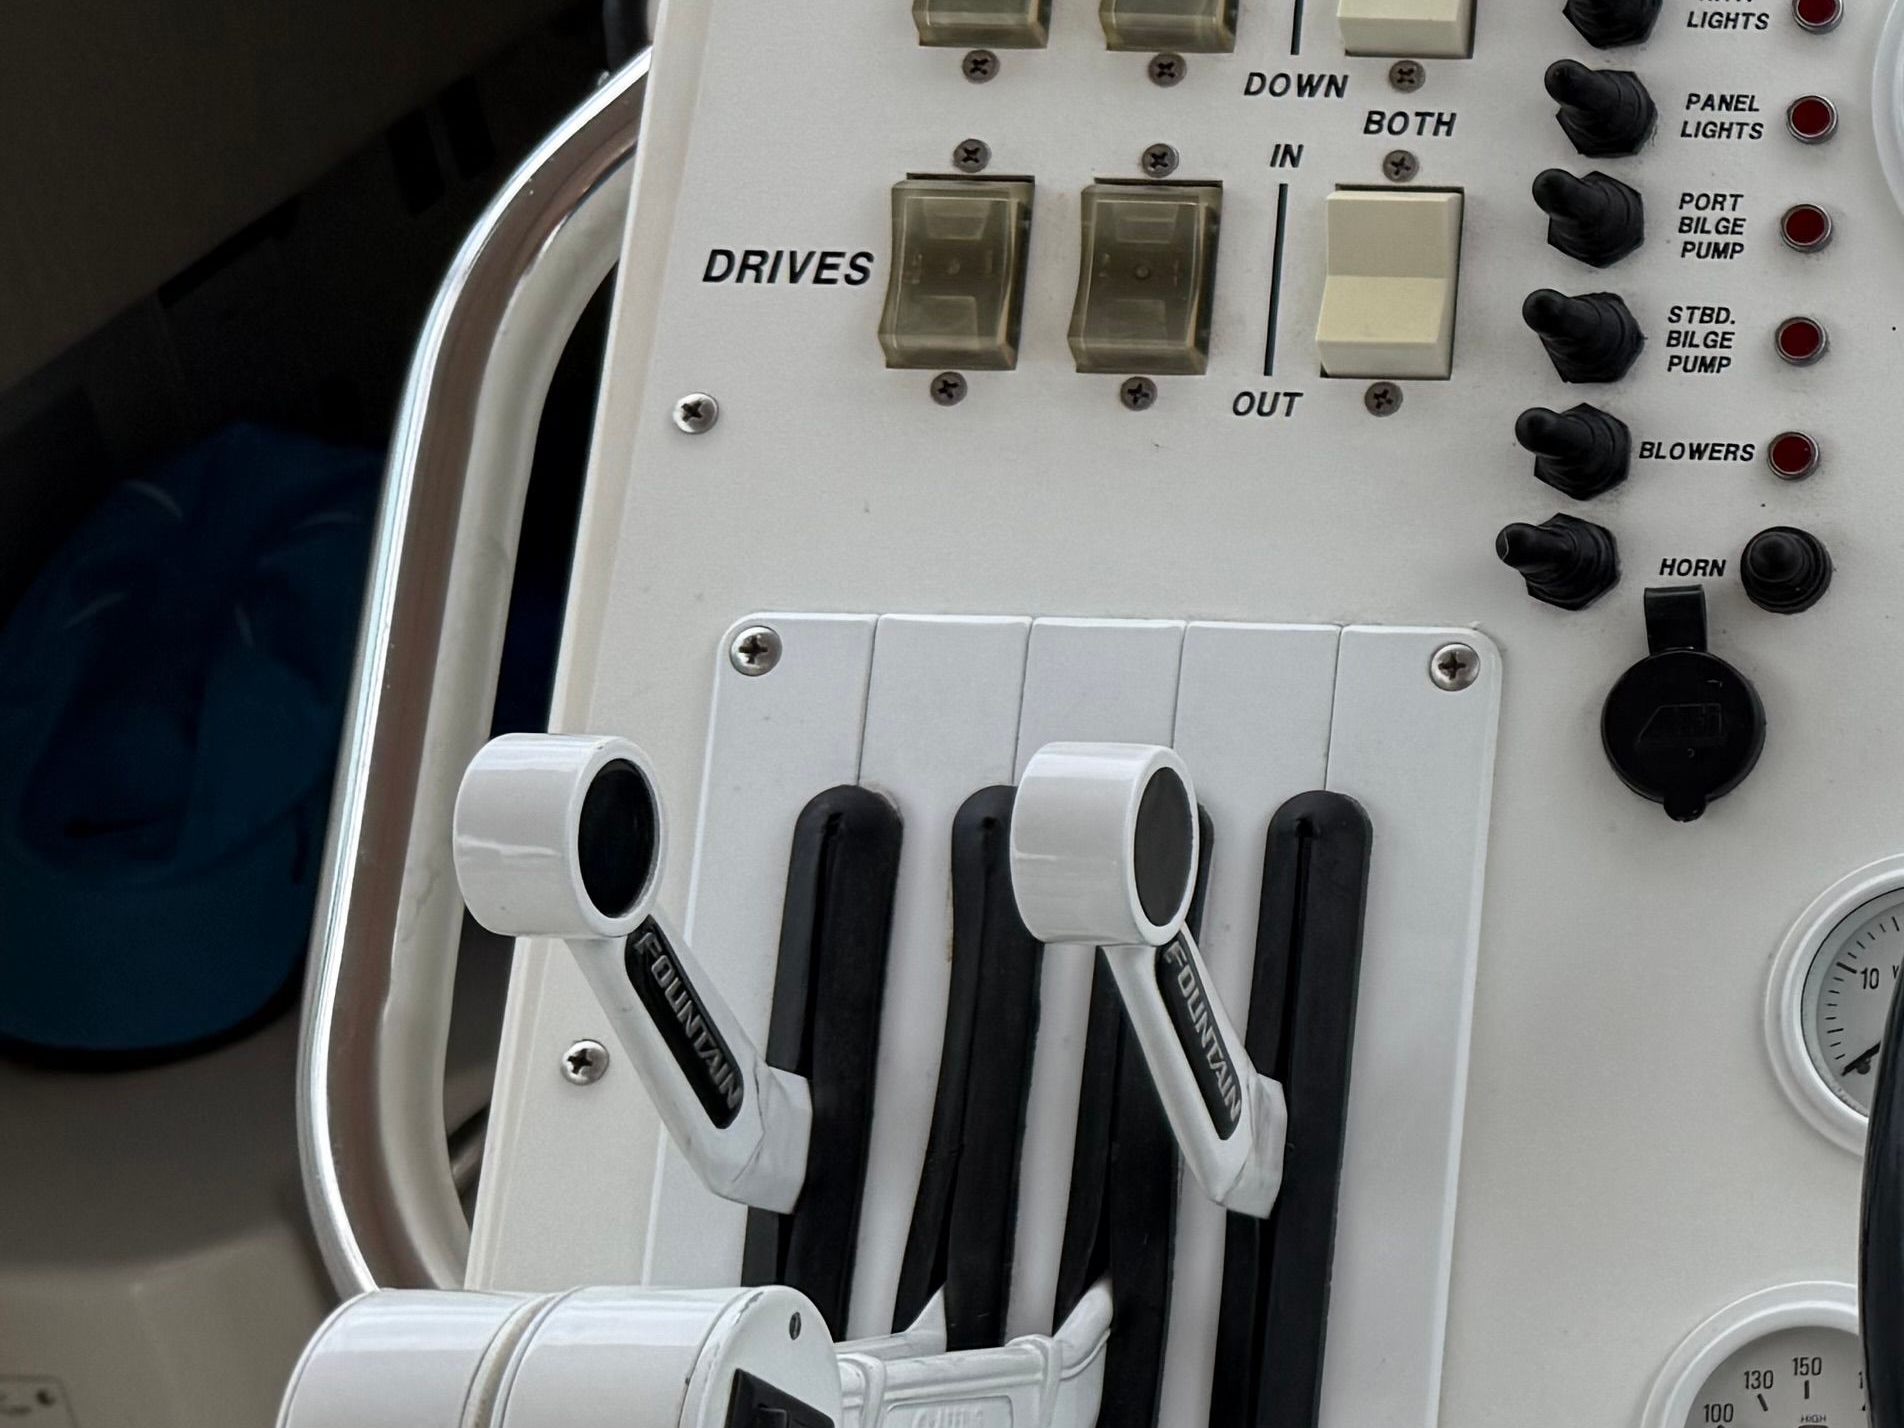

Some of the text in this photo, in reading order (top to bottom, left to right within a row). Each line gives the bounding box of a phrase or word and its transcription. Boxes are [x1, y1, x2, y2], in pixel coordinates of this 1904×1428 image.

[1686, 11, 1771, 31] LIGHTS
[1242, 71, 1349, 101] DOWN
[1685, 93, 1761, 113] PANEL
[1362, 110, 1457, 139] BOTH
[1680, 120, 1764, 140] LIGHTS
[1268, 142, 1304, 171] IN
[1678, 193, 1745, 212] PORT
[1678, 217, 1747, 236] BILGE
[1680, 241, 1745, 261] PUMP
[701, 247, 875, 288] DRIVES
[1667, 305, 1737, 325] STBD.
[1666, 330, 1735, 350] BILGE
[1666, 354, 1732, 374] PUMP
[1231, 389, 1303, 420] OUT
[1638, 441, 1756, 463] BLOWERS
[1658, 557, 1727, 578] HORN
[1792, 1357, 1823, 1377] 150
[1744, 1370, 1774, 1390] 130
[1703, 1403, 1734, 1423] 100
